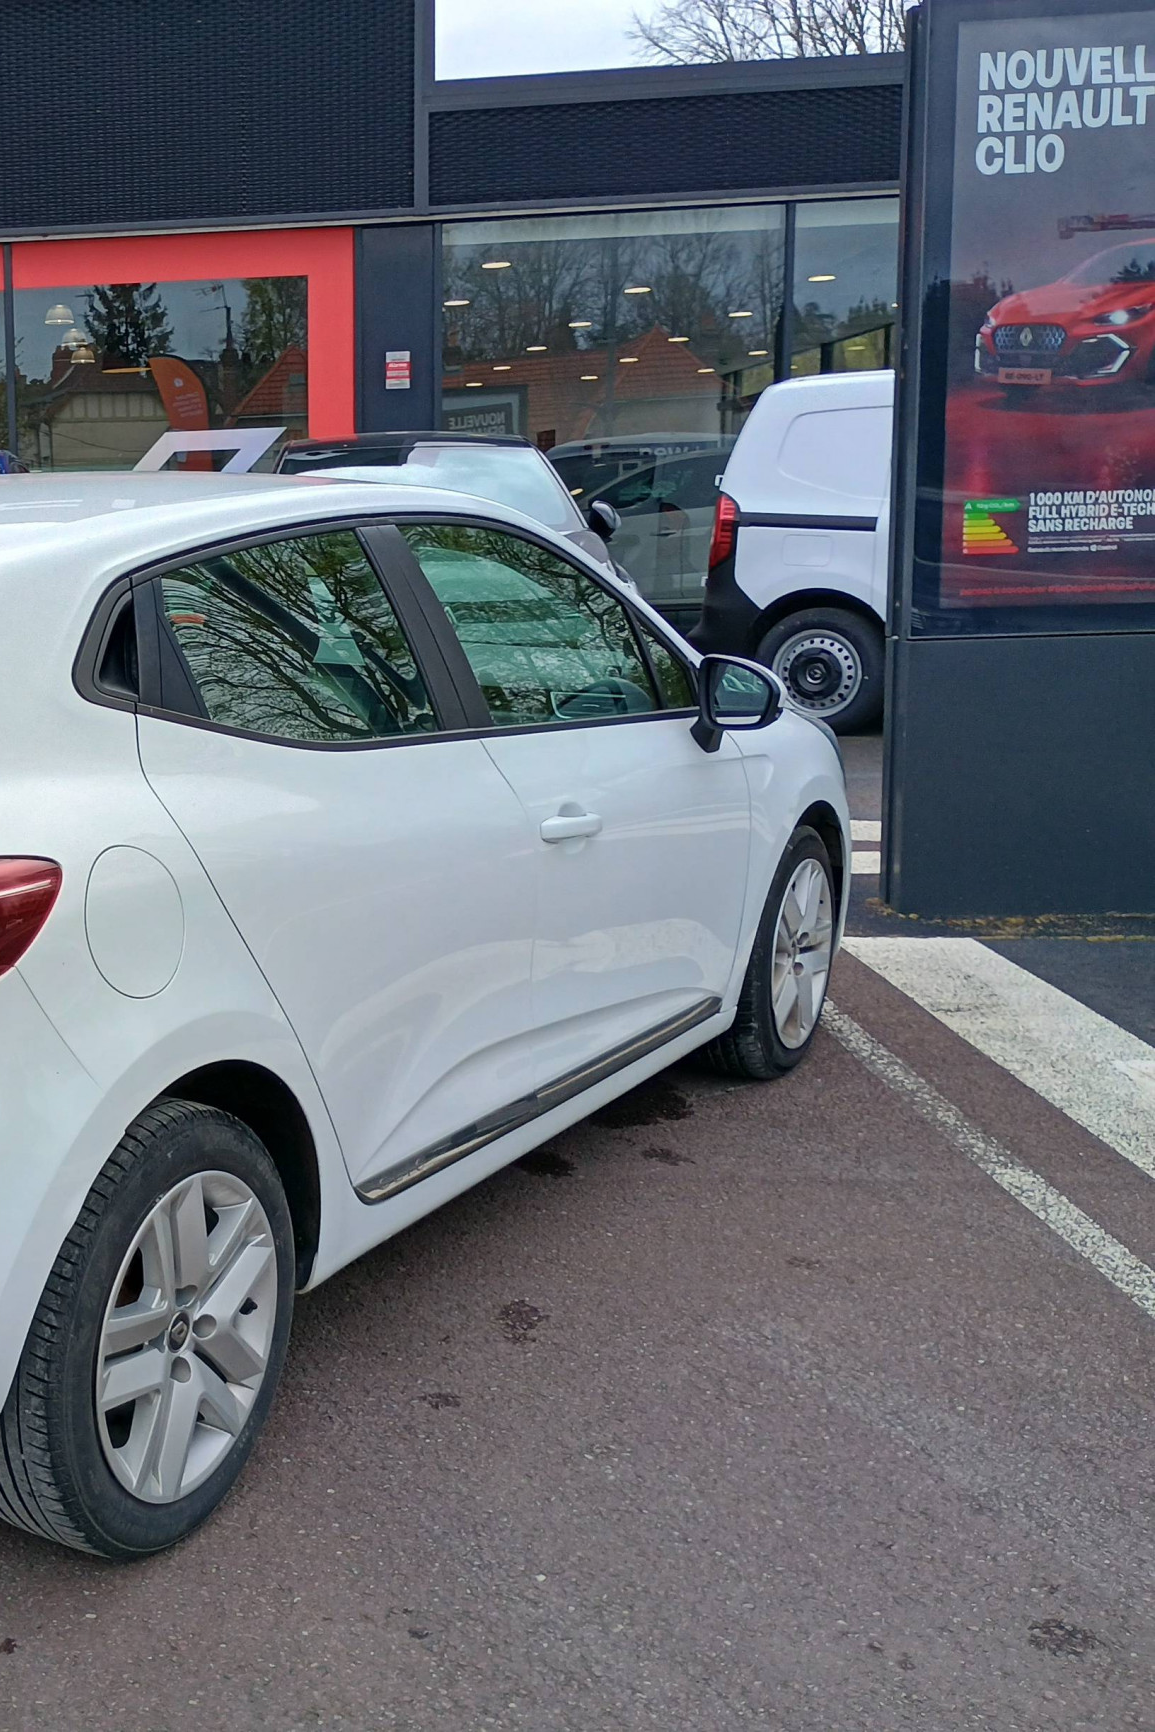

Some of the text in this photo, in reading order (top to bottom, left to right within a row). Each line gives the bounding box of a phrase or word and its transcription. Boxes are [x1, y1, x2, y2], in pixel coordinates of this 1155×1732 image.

[977, 86, 1155, 133] RENAULT
[975, 133, 1065, 175] CLIO
[1064, 491, 1084, 505] KM
[1028, 506, 1060, 519] FULL
[1061, 504, 1109, 518] HYBRID
[1111, 503, 1155, 516] E-TECH
[1027, 516, 1134, 532] SANS RECHARGE
